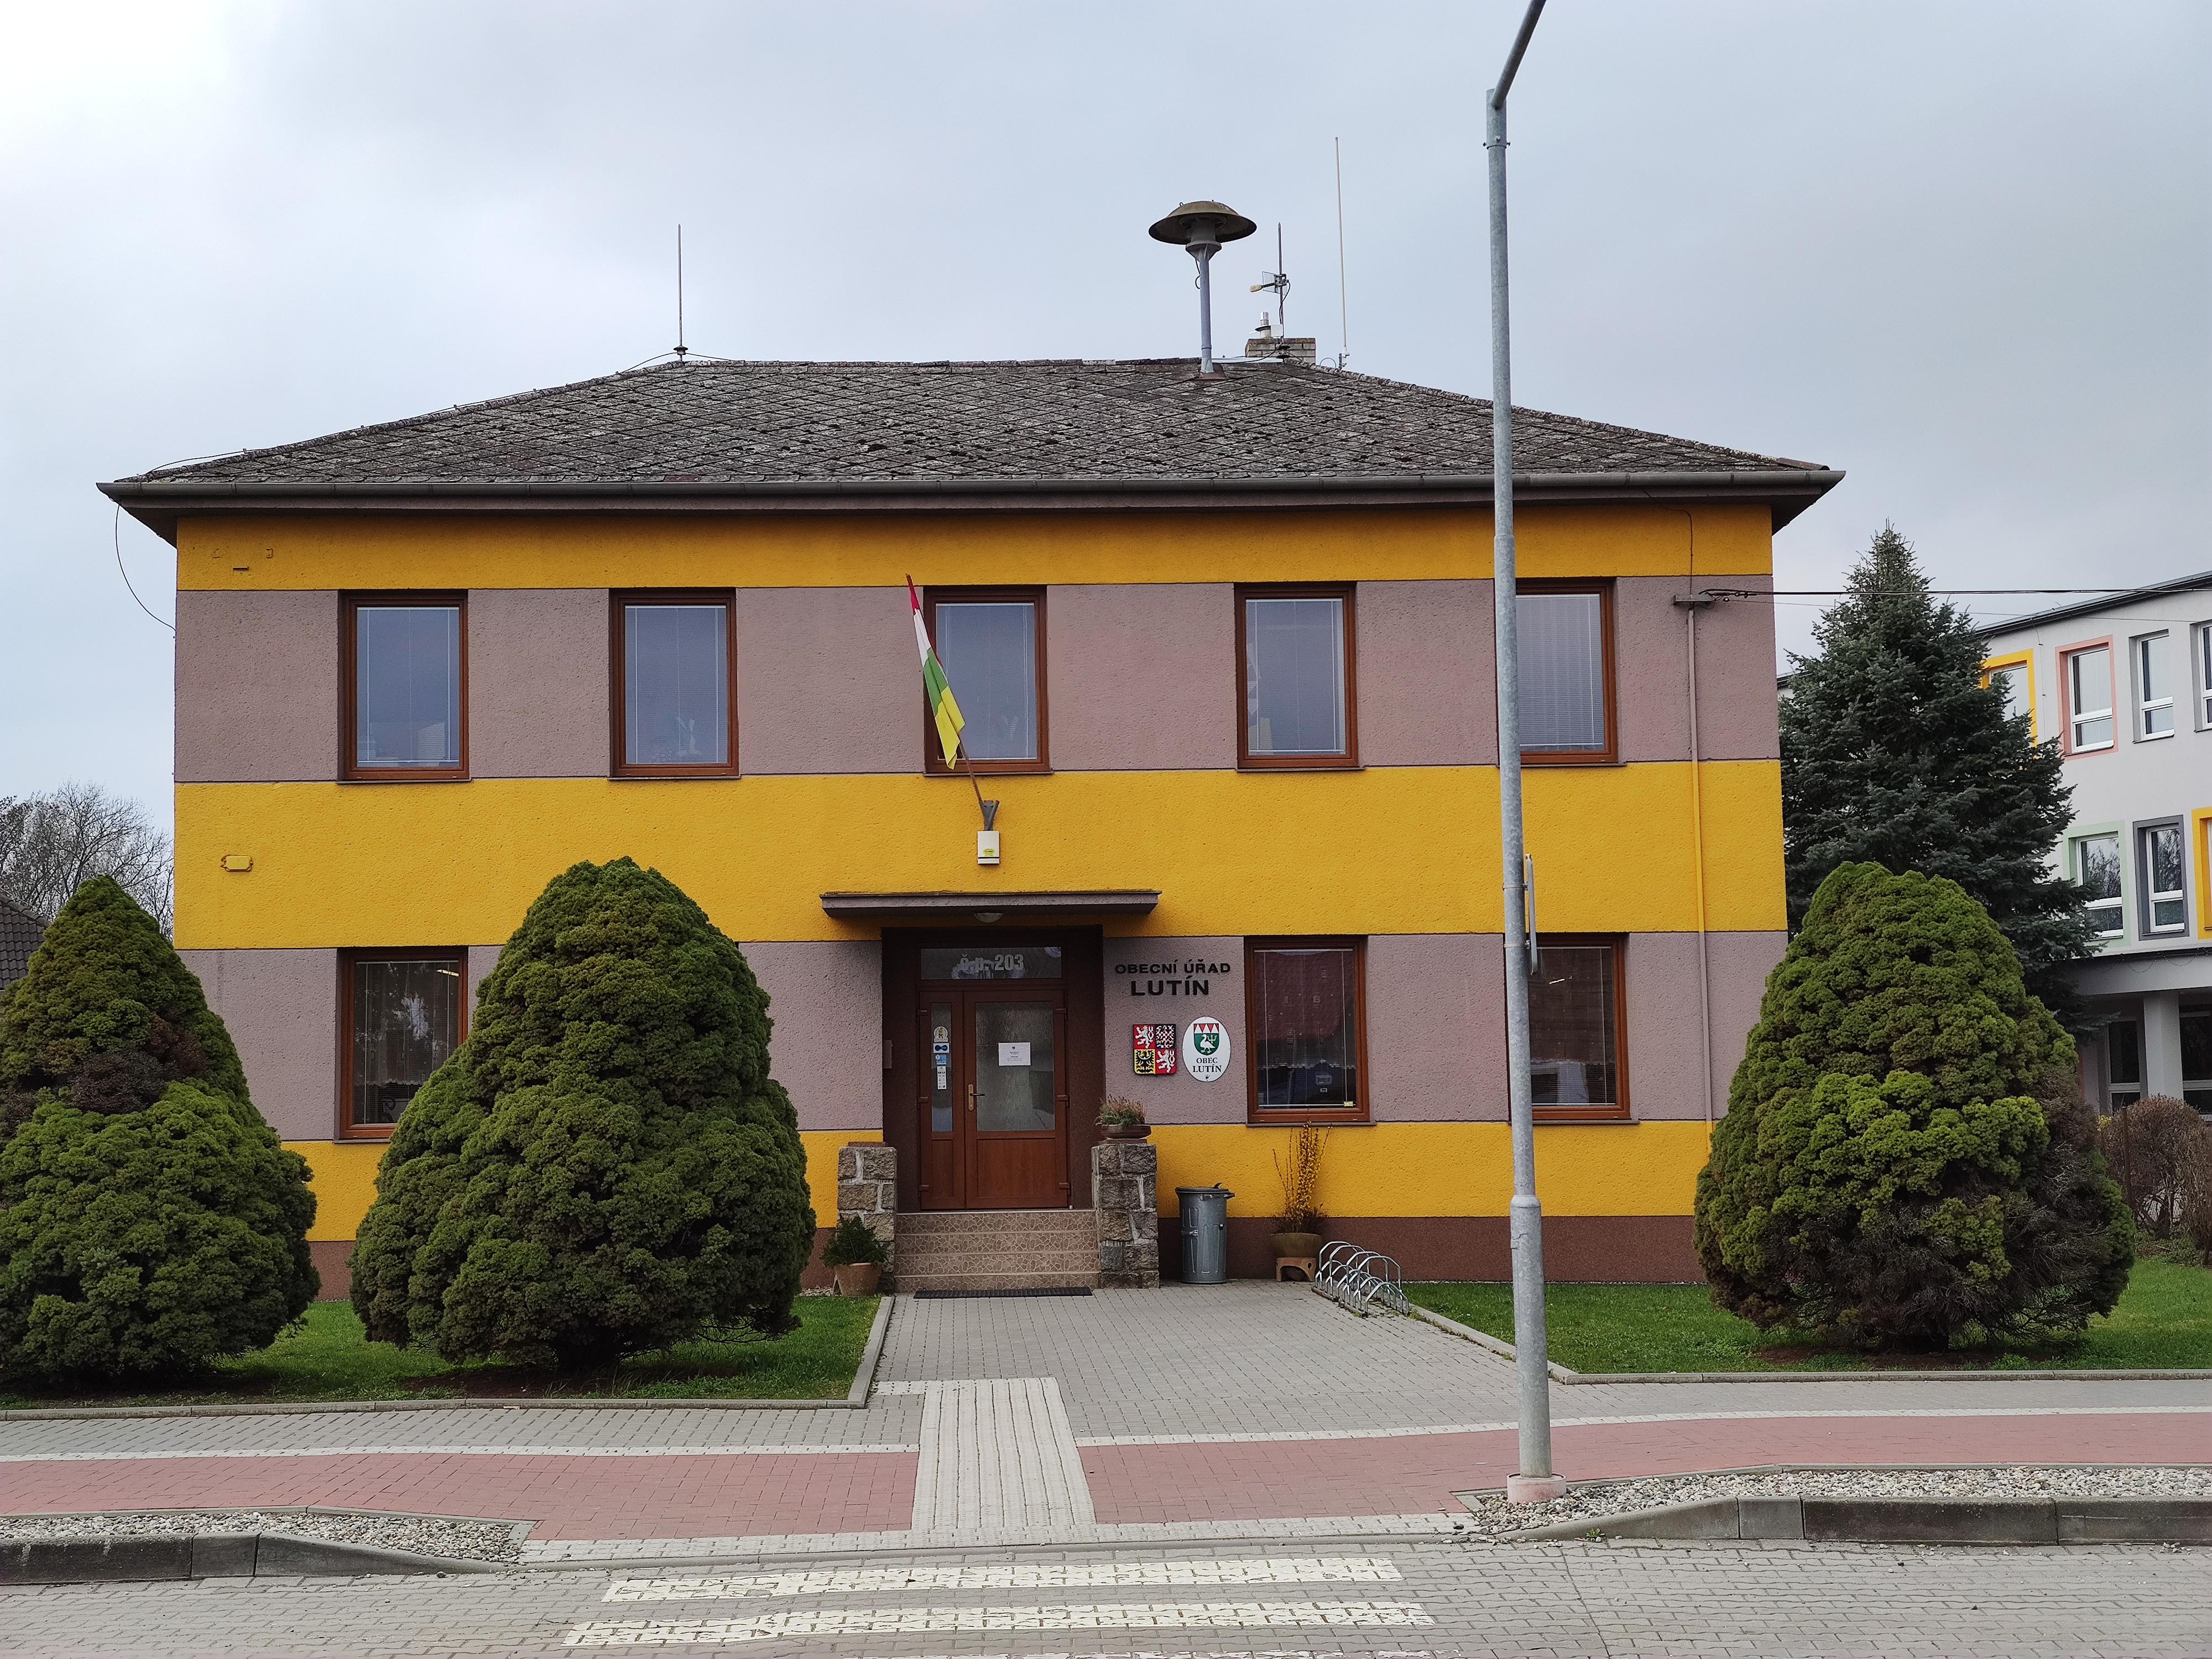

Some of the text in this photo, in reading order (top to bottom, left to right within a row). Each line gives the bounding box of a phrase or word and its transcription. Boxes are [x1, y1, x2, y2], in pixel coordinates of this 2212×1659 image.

[995, 954, 1024, 971] 203
[1115, 959, 1231, 974] OBECNÍ ÚŘAD
[1131, 975, 1209, 996] LUTÍN
[1192, 1063, 1222, 1073] LUTÍN
